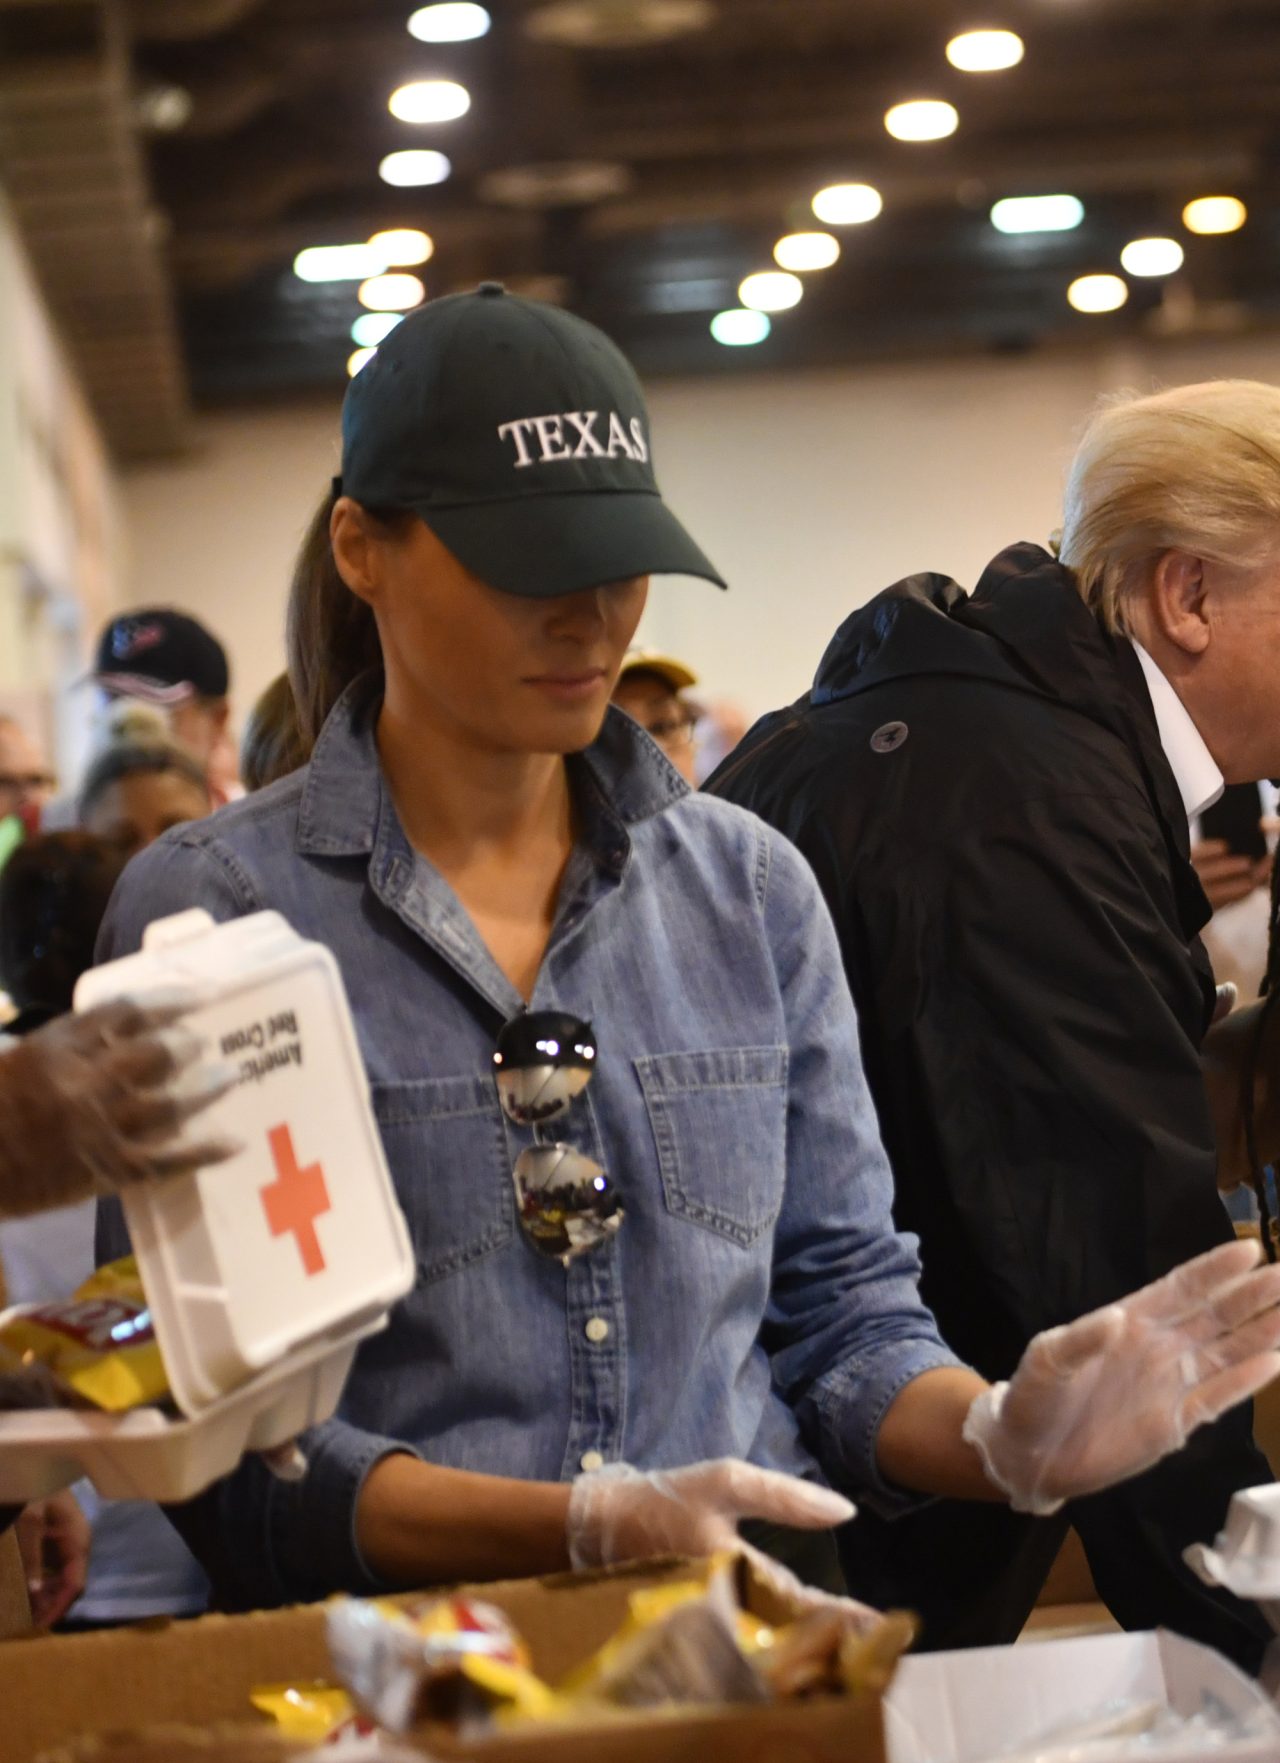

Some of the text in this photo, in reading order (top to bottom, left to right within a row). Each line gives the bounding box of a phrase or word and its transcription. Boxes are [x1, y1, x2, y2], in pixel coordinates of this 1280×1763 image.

[497, 410, 648, 468] TEXAS
[220, 1008, 299, 1056] Red Cross
[238, 1041, 303, 1083] Americ
